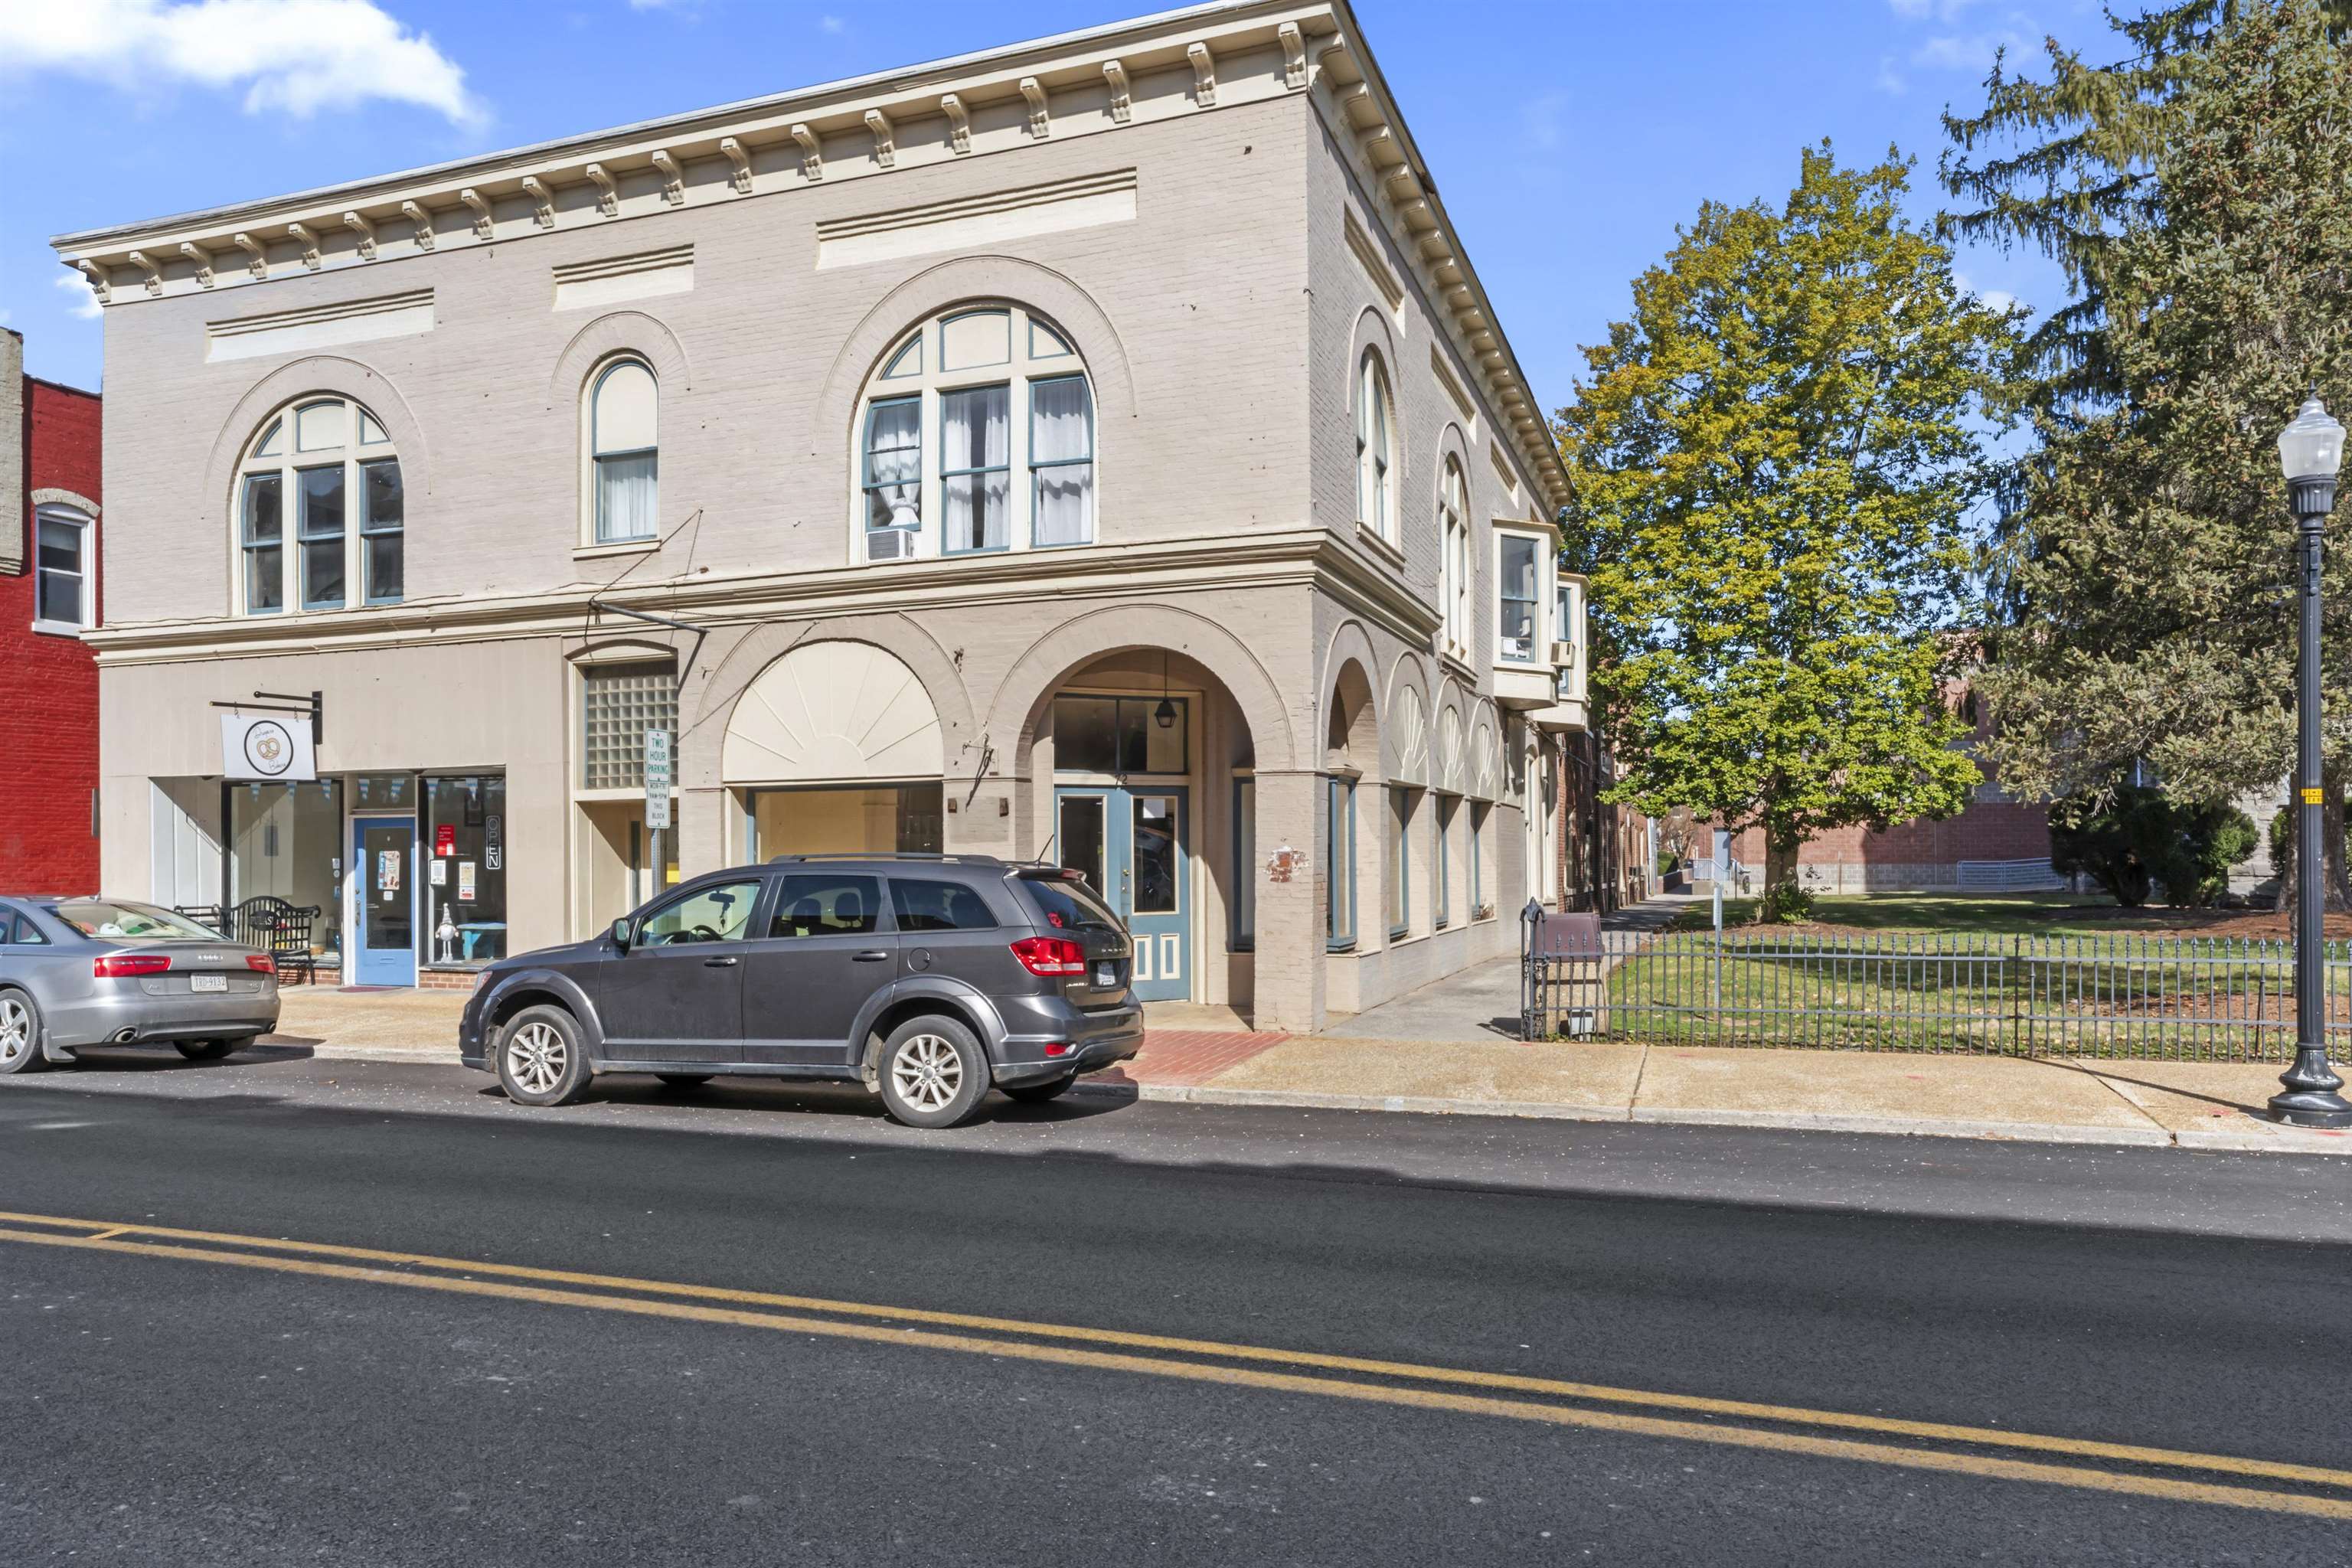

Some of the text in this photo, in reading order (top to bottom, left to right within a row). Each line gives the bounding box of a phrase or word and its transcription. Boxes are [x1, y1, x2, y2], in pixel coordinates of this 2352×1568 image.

[652, 737, 664, 749] TWO
[649, 750, 666, 762] HOUR
[648, 764, 668, 775] PARKING
[488, 818, 498, 867] OPEN
